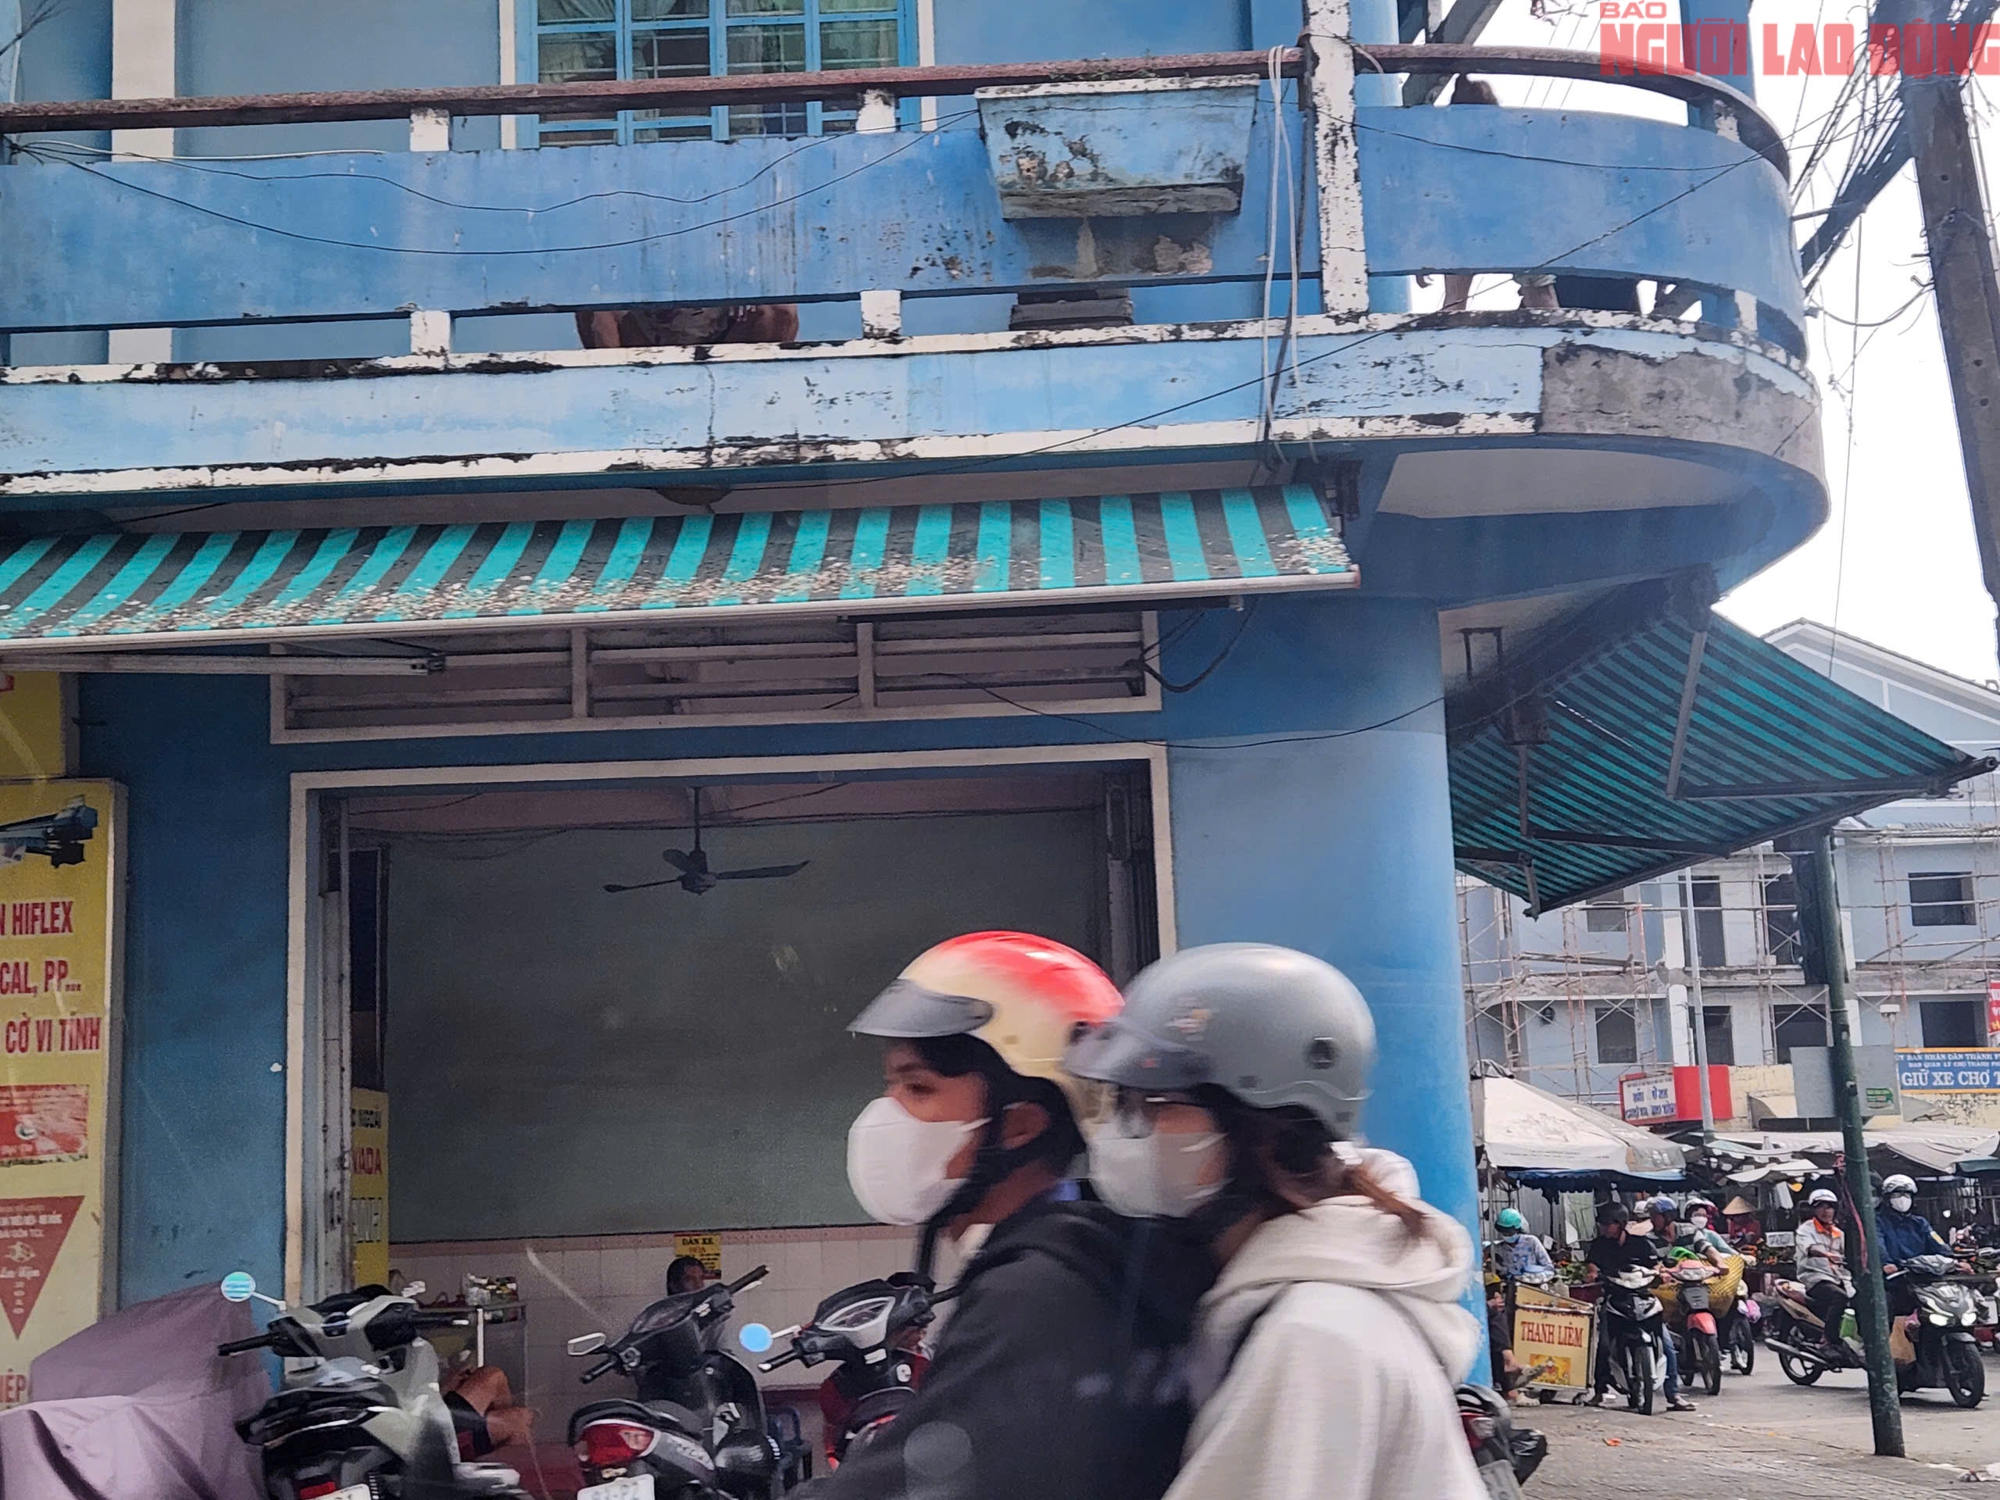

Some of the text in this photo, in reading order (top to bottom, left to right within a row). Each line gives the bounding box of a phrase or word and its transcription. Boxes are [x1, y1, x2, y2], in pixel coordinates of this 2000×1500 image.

[12, 901, 74, 935] HIFLEX
[36, 1019, 53, 1052] VI
[1901, 1069, 1930, 1086] GIỮ
[1931, 1071, 1955, 1086] XE
[1957, 1069, 1990, 1088] CHỢ
[1521, 1321, 1556, 1345] THANH
